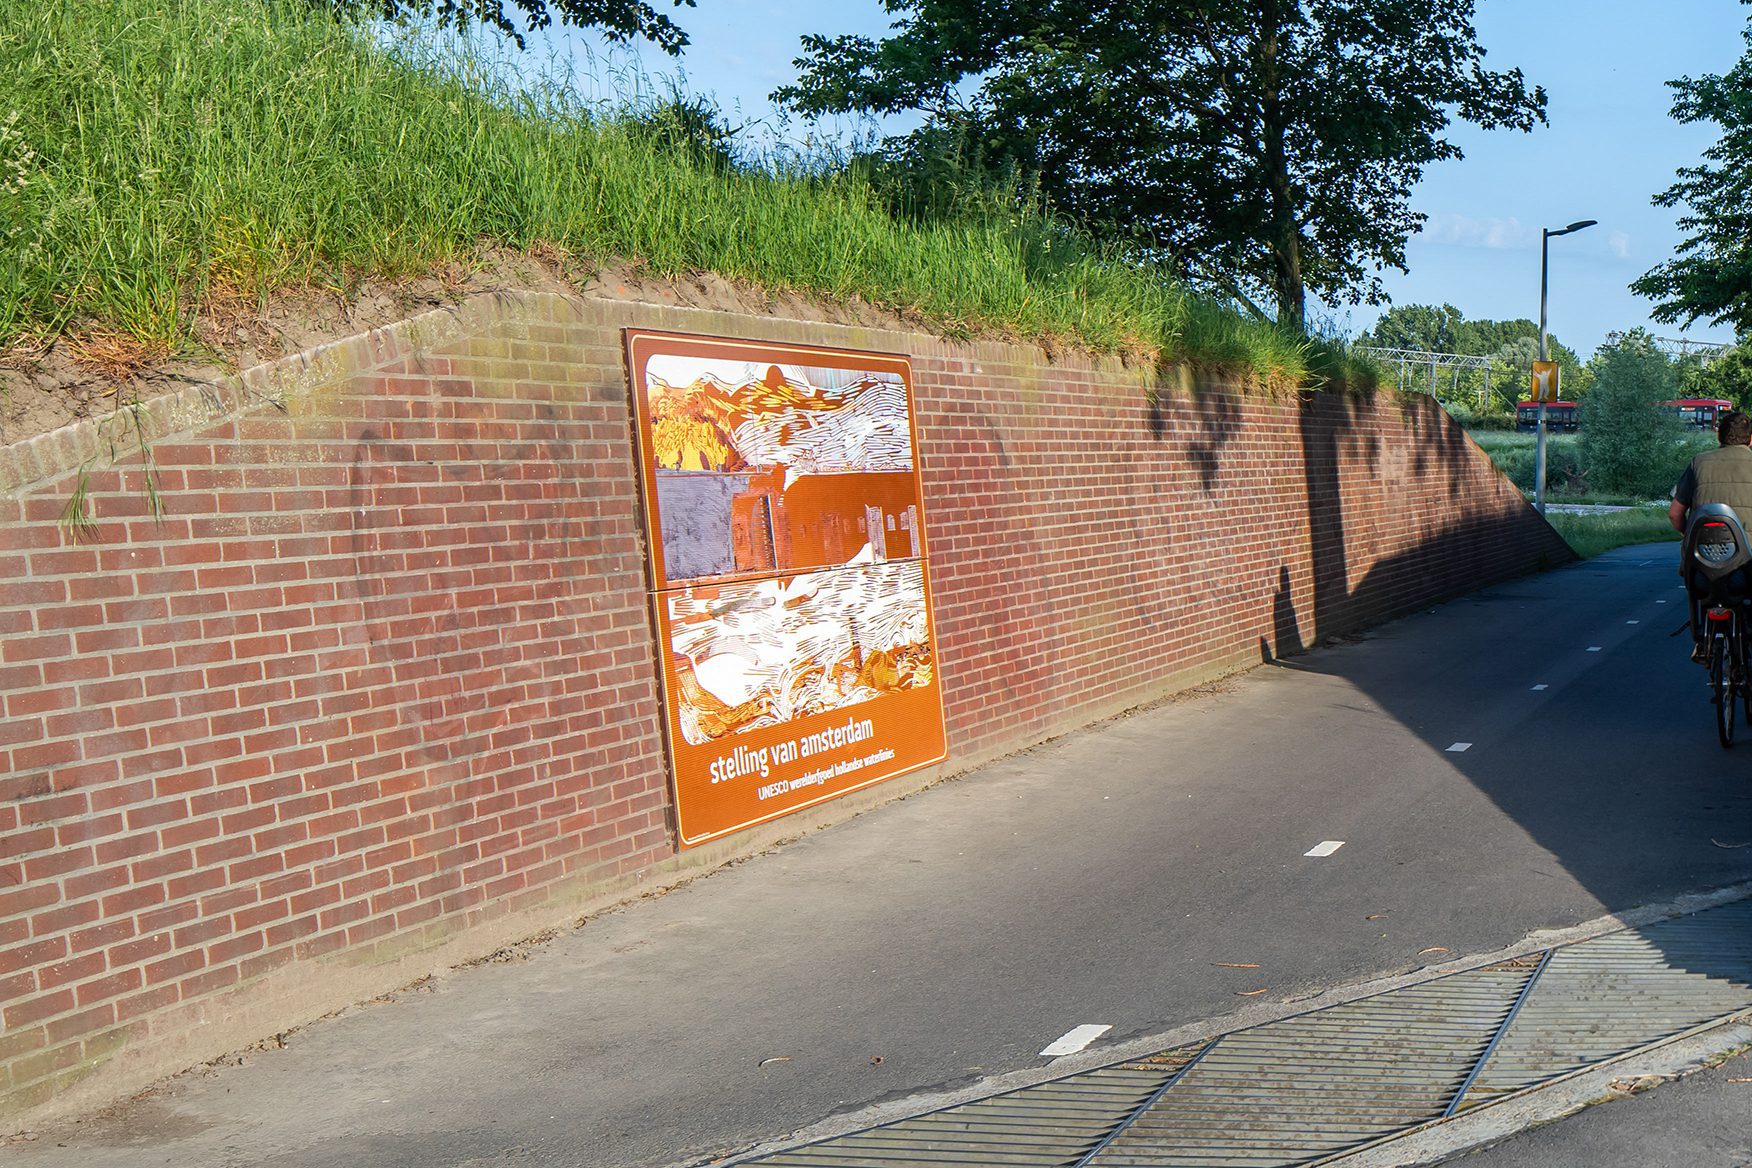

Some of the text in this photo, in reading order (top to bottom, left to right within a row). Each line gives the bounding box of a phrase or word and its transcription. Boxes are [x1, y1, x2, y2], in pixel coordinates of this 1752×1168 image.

[709, 716, 874, 784] stelling van amsterdam
[757, 747, 896, 801] UNESCO werelderfgoed hollandse waterlinies
